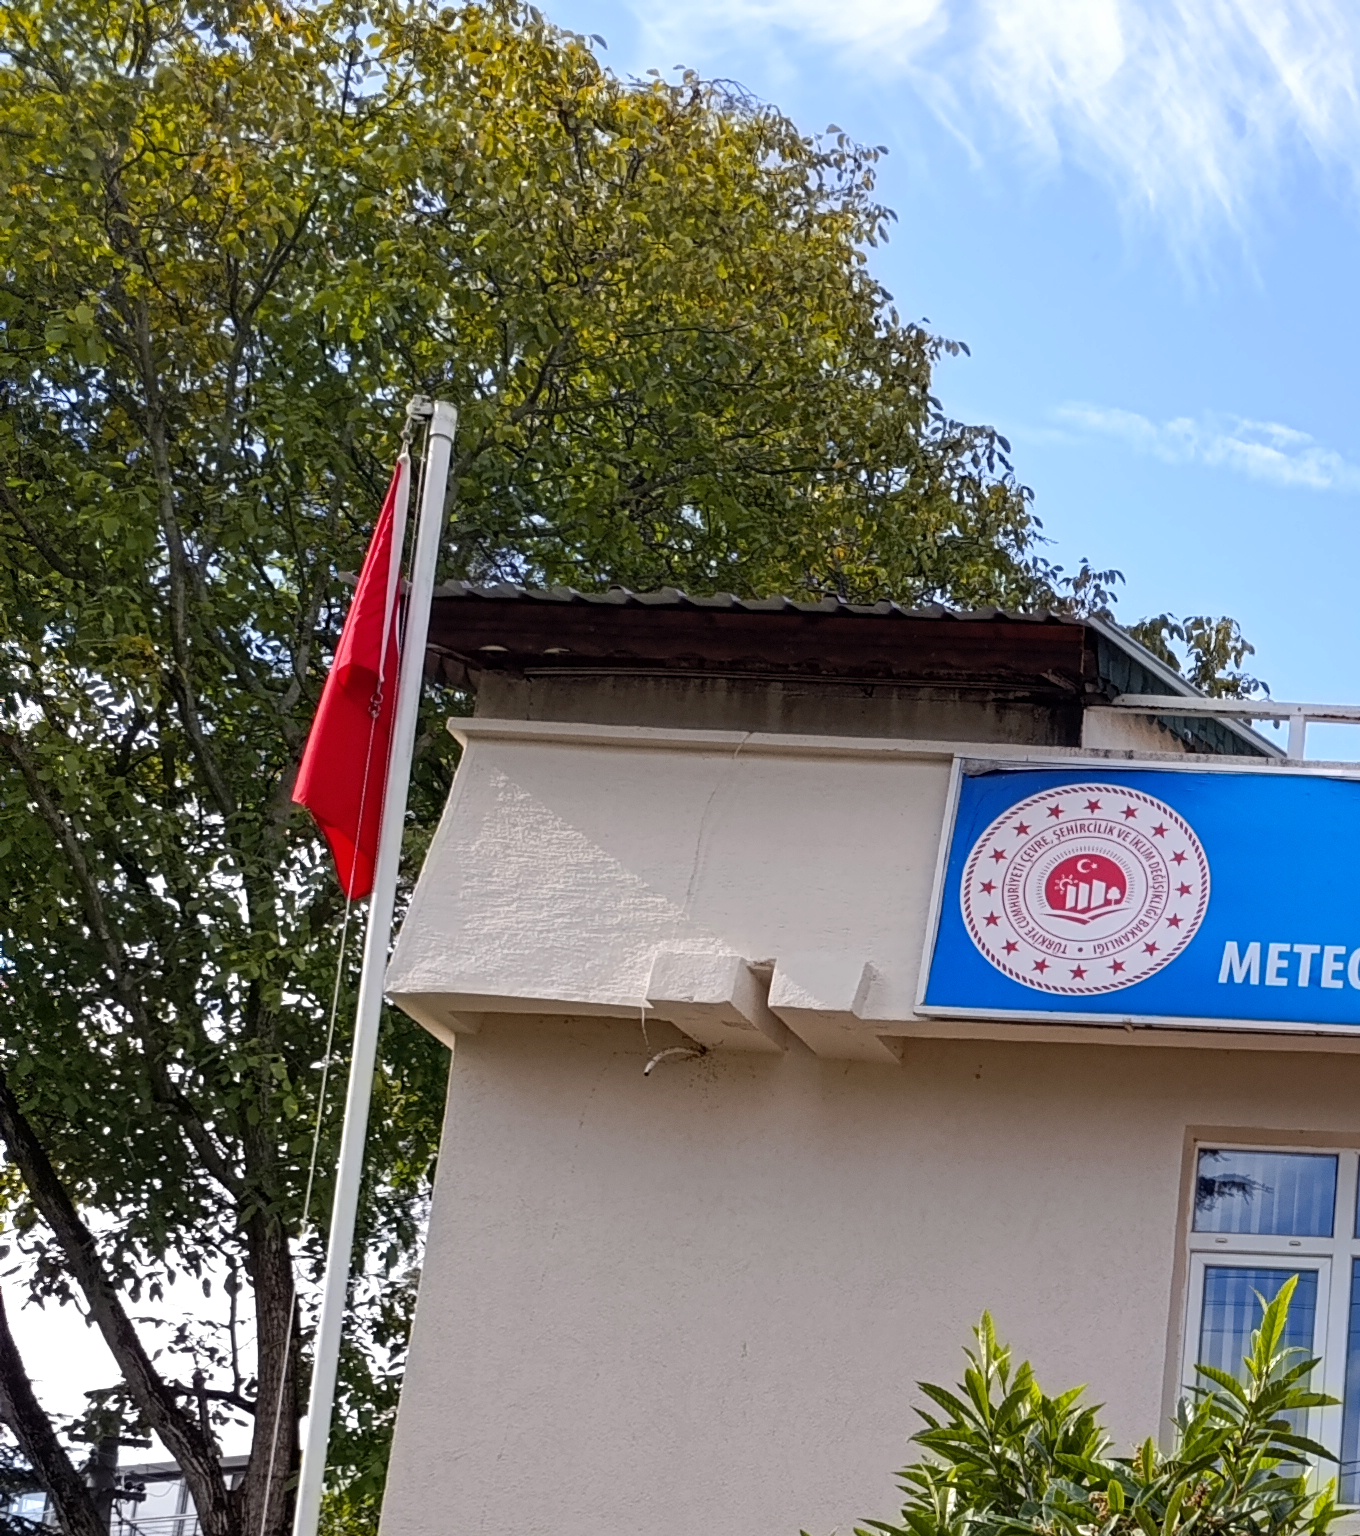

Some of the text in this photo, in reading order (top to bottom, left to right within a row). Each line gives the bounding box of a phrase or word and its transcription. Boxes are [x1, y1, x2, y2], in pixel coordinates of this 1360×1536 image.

[1053, 822, 1115, 843] ŞEHİRCİLİK
[1117, 829, 1132, 842] VE
[1130, 834, 1154, 862] İKLİM
[1007, 863, 1026, 929] CUMHURİYETİ
[1148, 861, 1167, 922] DEĞİŞİKLİĞİ
[1025, 926, 1068, 955] TÜRKİYE
[1092, 918, 1149, 955] BAKANLIĞI
